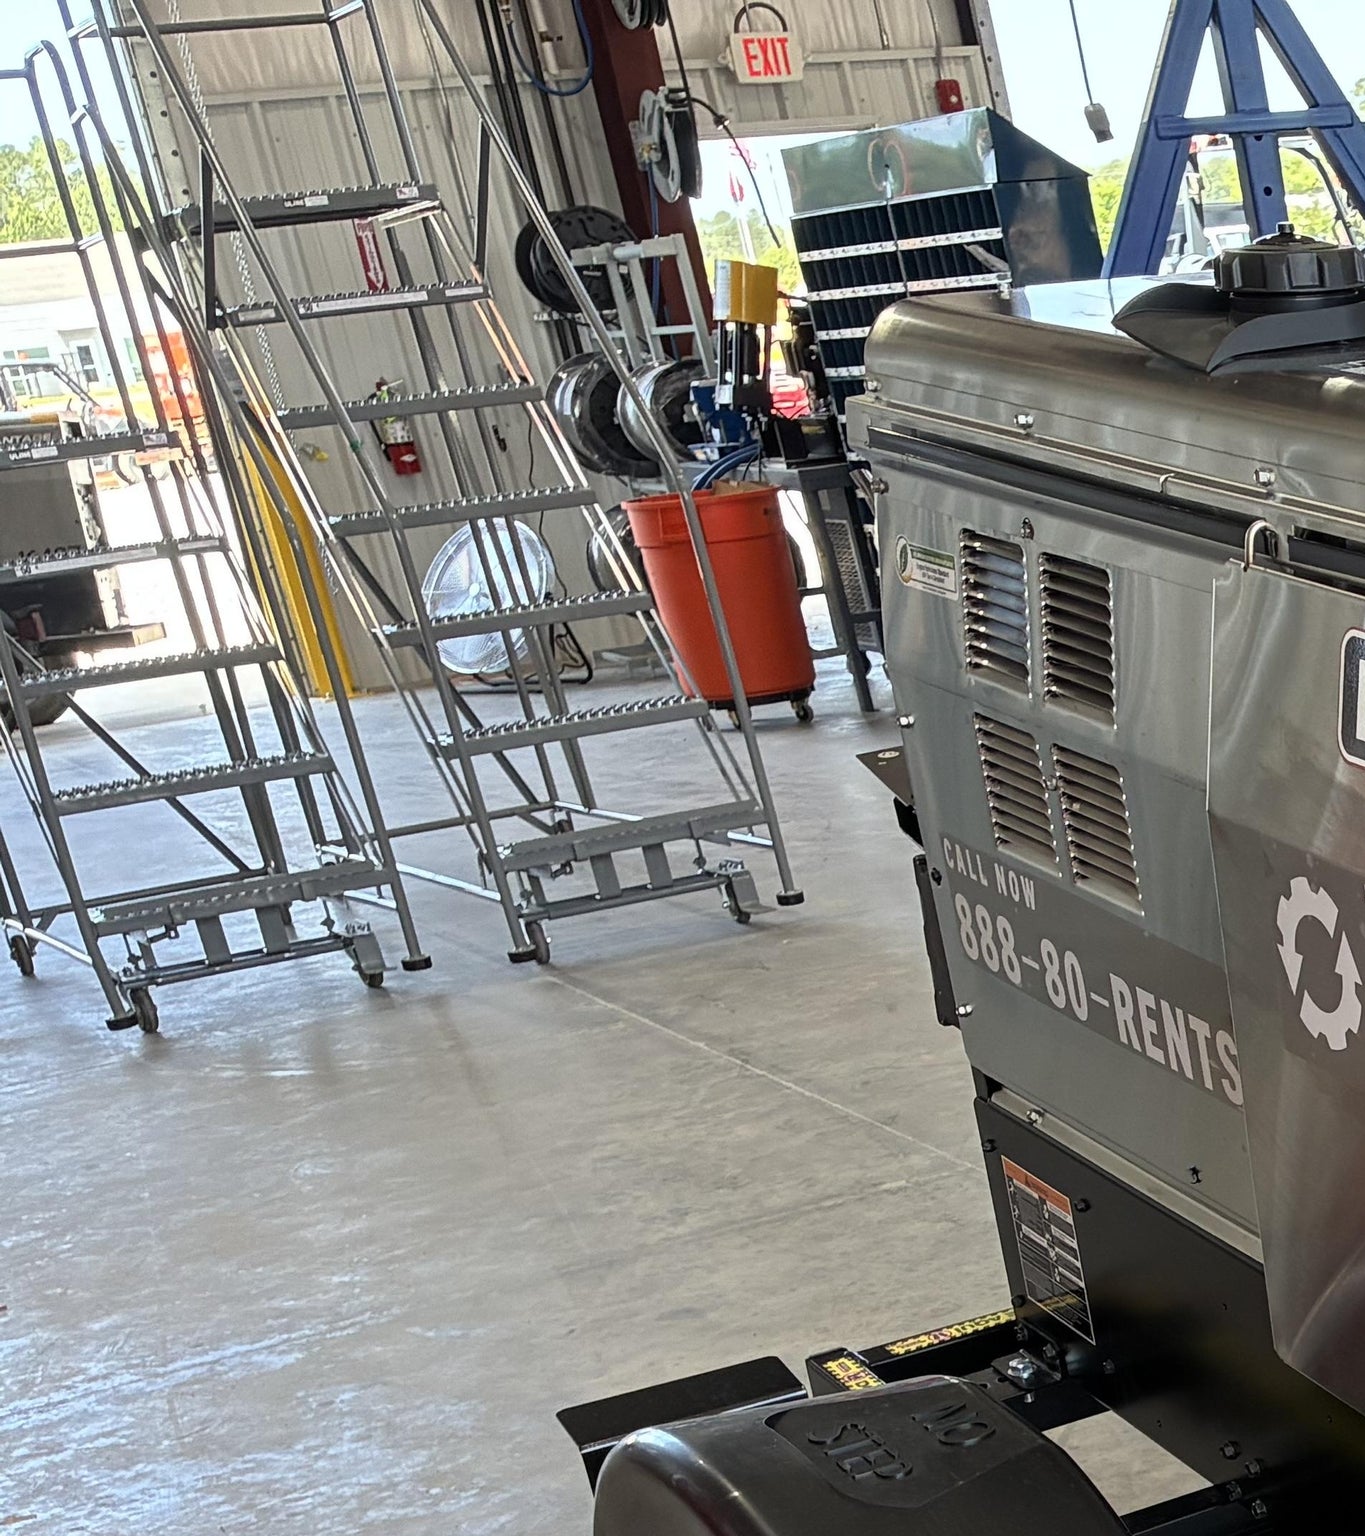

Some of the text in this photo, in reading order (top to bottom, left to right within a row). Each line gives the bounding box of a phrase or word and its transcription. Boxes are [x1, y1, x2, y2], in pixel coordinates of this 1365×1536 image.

[742, 37, 791, 76] EXIT
[943, 837, 1037, 912] CALL NOW
[954, 891, 1244, 1107] 888-80-RENTS
[808, 1423, 913, 1480] STEP
